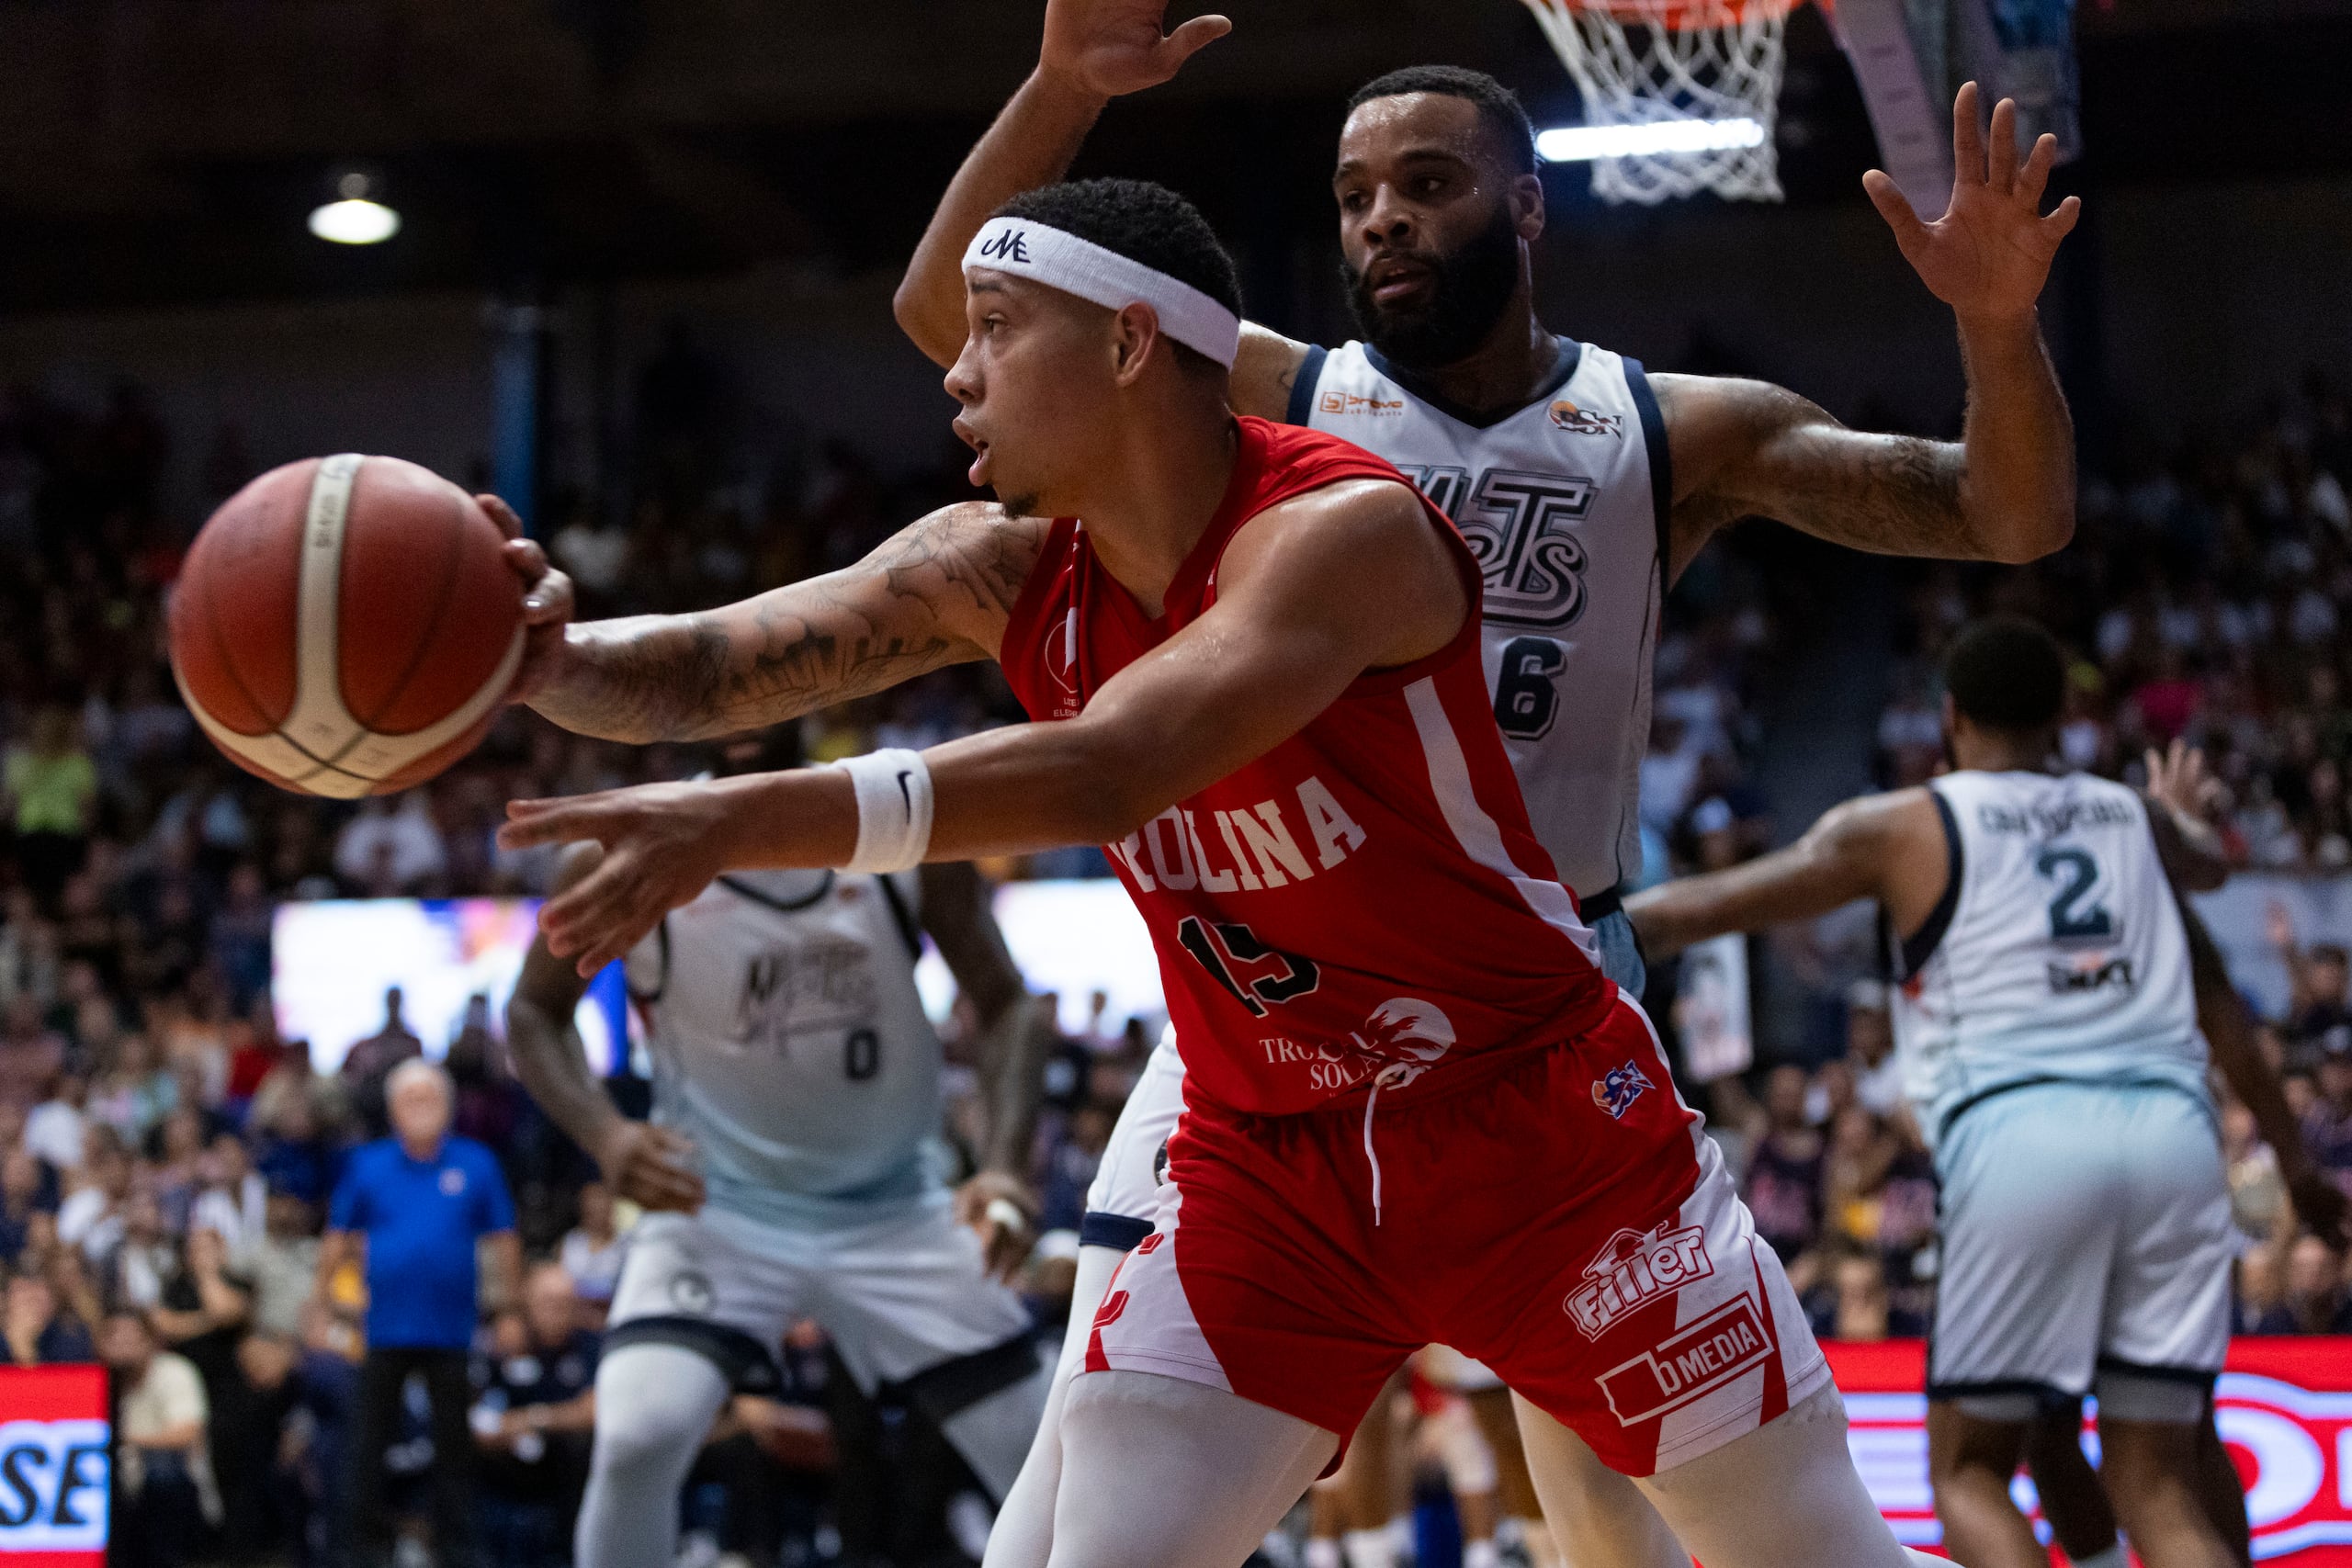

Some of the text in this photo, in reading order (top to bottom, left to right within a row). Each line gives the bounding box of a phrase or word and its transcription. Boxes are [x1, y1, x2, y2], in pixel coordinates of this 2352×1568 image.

[1494, 636, 1567, 740] 6
[2037, 849, 2111, 937] 2
[1177, 916, 1321, 1019] 15
[1572, 1235, 1702, 1333] Filler
